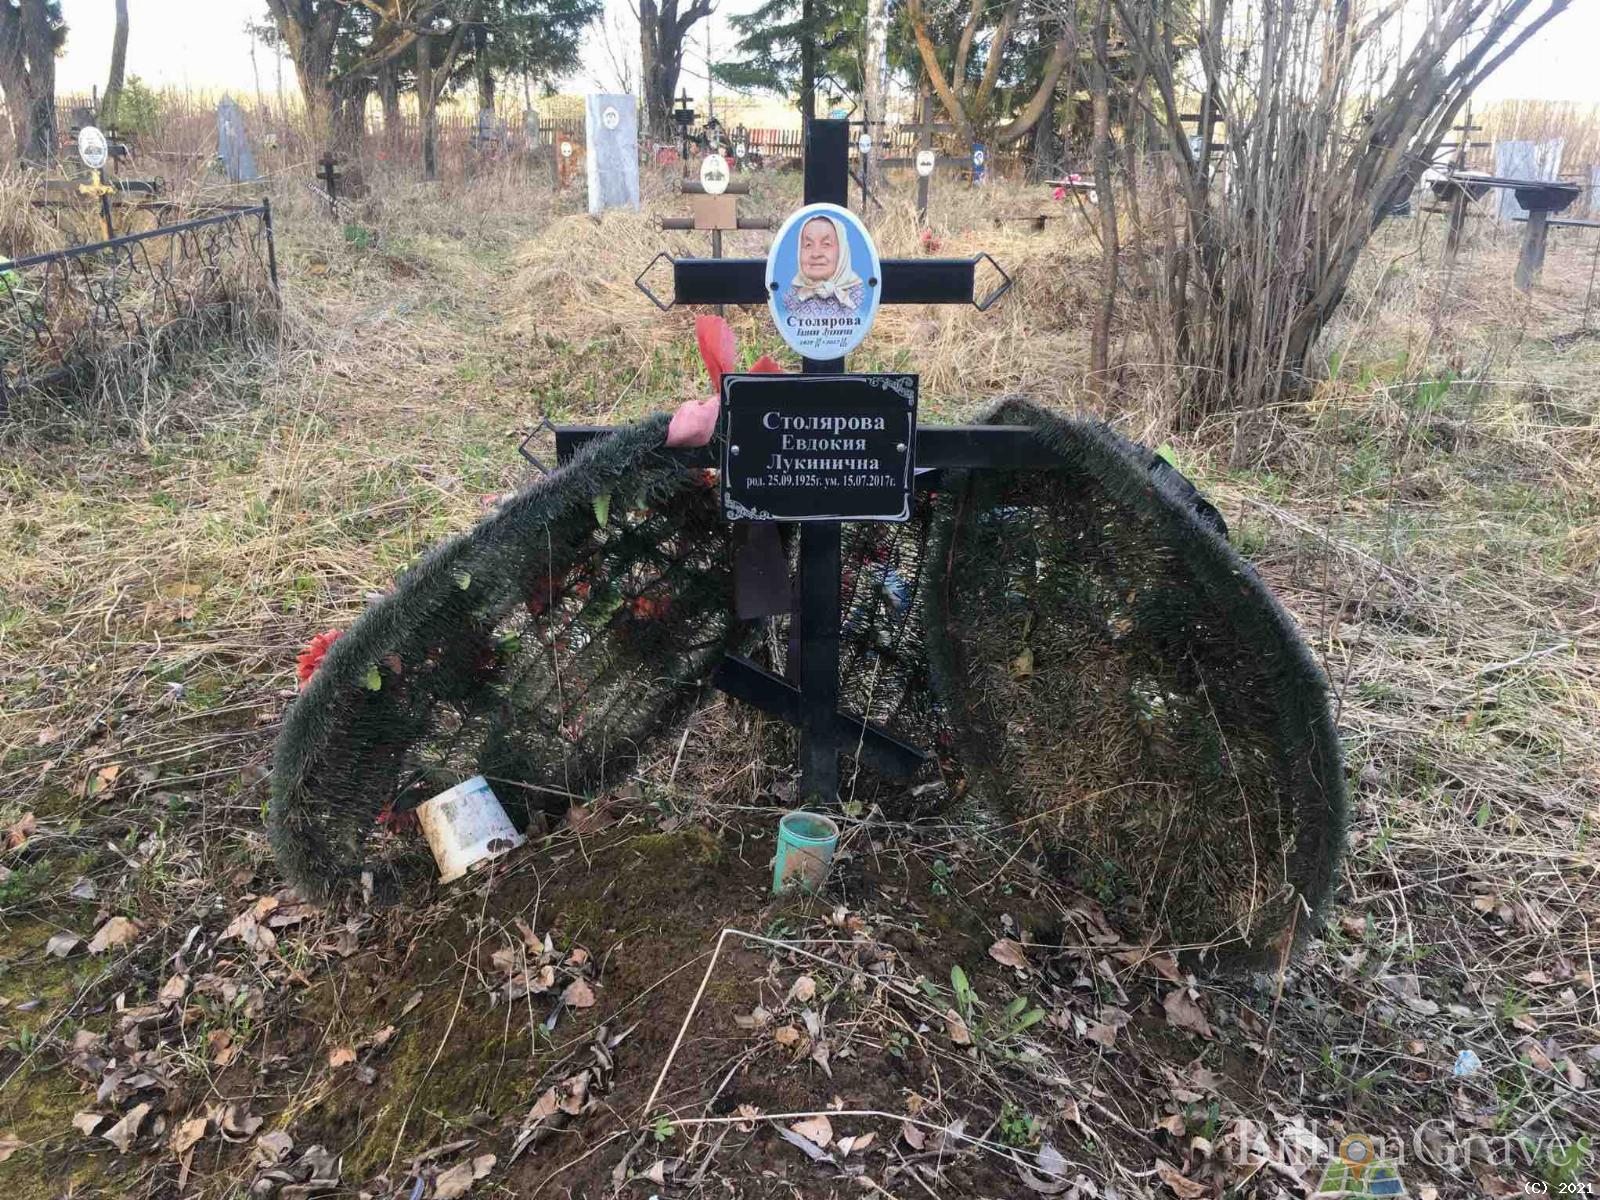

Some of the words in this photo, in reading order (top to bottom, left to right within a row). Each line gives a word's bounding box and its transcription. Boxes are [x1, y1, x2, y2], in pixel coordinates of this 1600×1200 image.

[786, 315, 862, 328] Столярова
[762, 411, 885, 434] Столярова
[782, 434, 866, 452] Евдокия
[766, 454, 880, 473] Лукинична
[746, 476, 766, 489] род.
[768, 474, 822, 487] 25.09.1925г.
[824, 476, 840, 490] ум.
[843, 475, 896, 487] 15.07.2017г.
